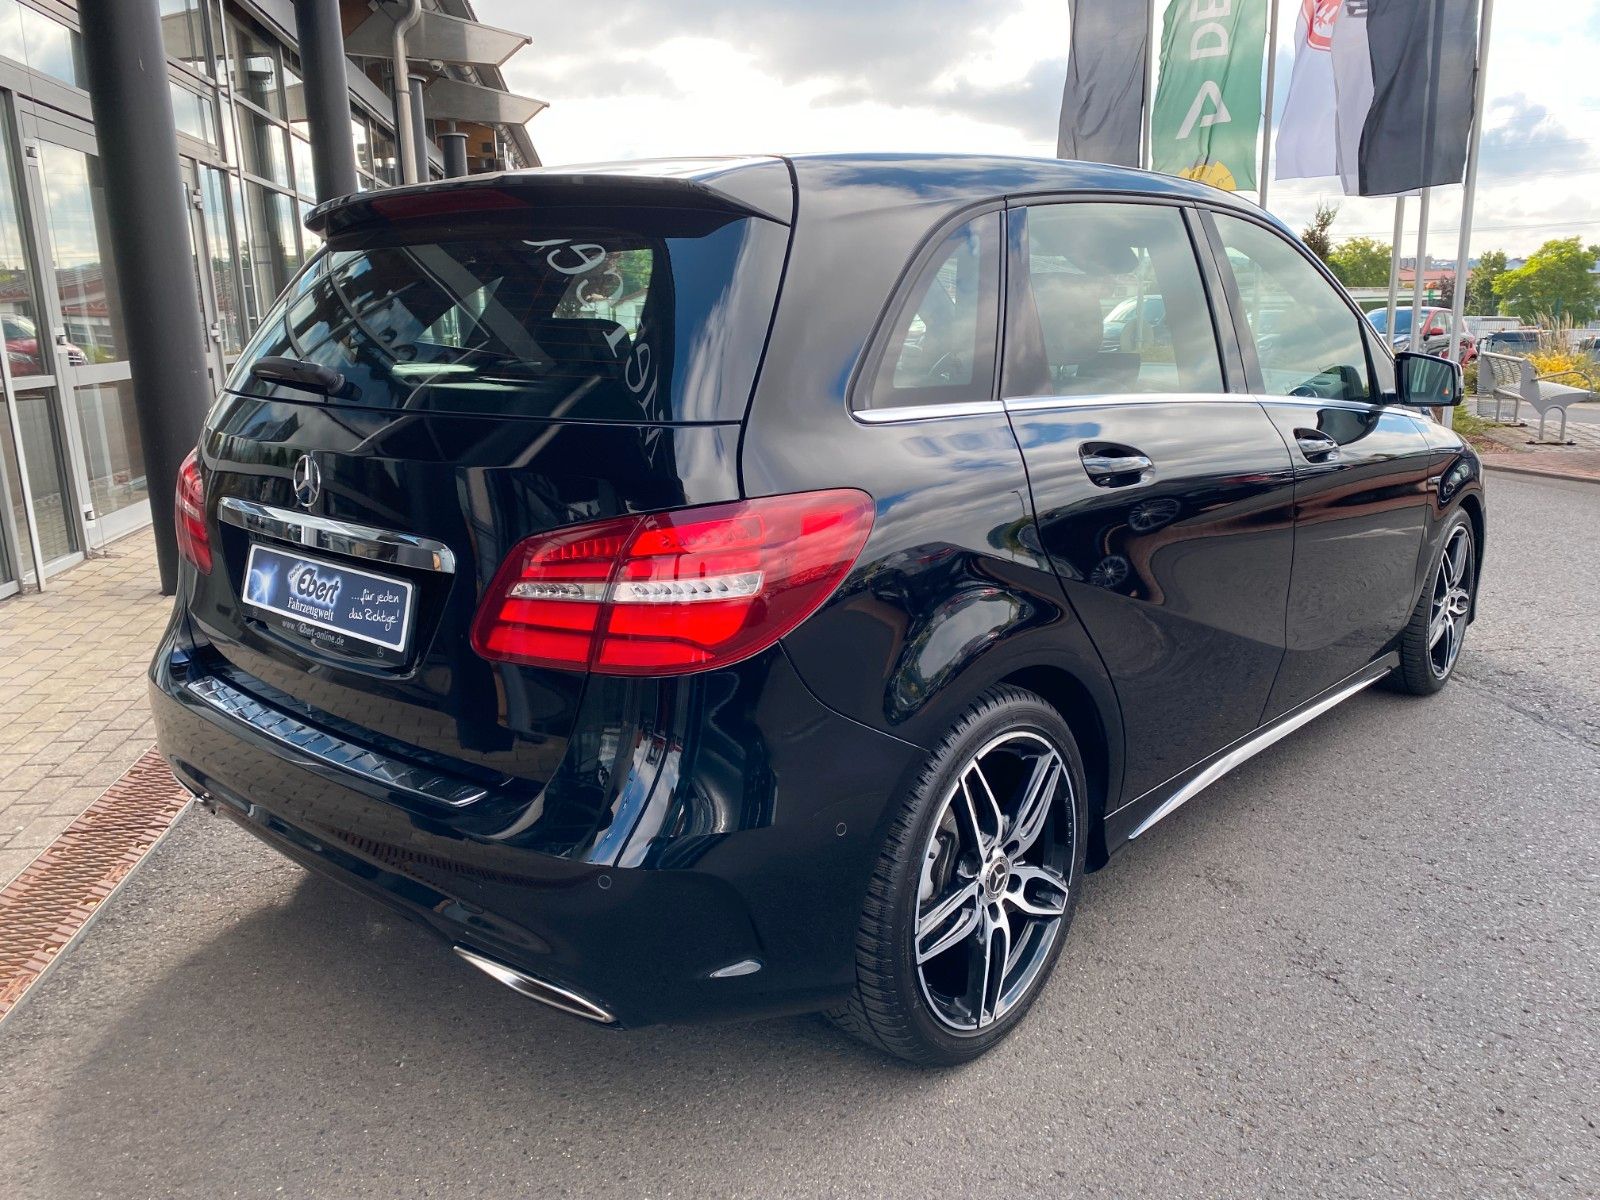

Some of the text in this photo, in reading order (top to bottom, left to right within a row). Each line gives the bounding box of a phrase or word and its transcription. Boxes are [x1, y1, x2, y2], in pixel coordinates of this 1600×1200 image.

[297, 567, 339, 604] Ebert
[376, 590, 399, 603] jeden
[287, 597, 334, 621] Fahrzeugwelt
[348, 607, 363, 620] das
